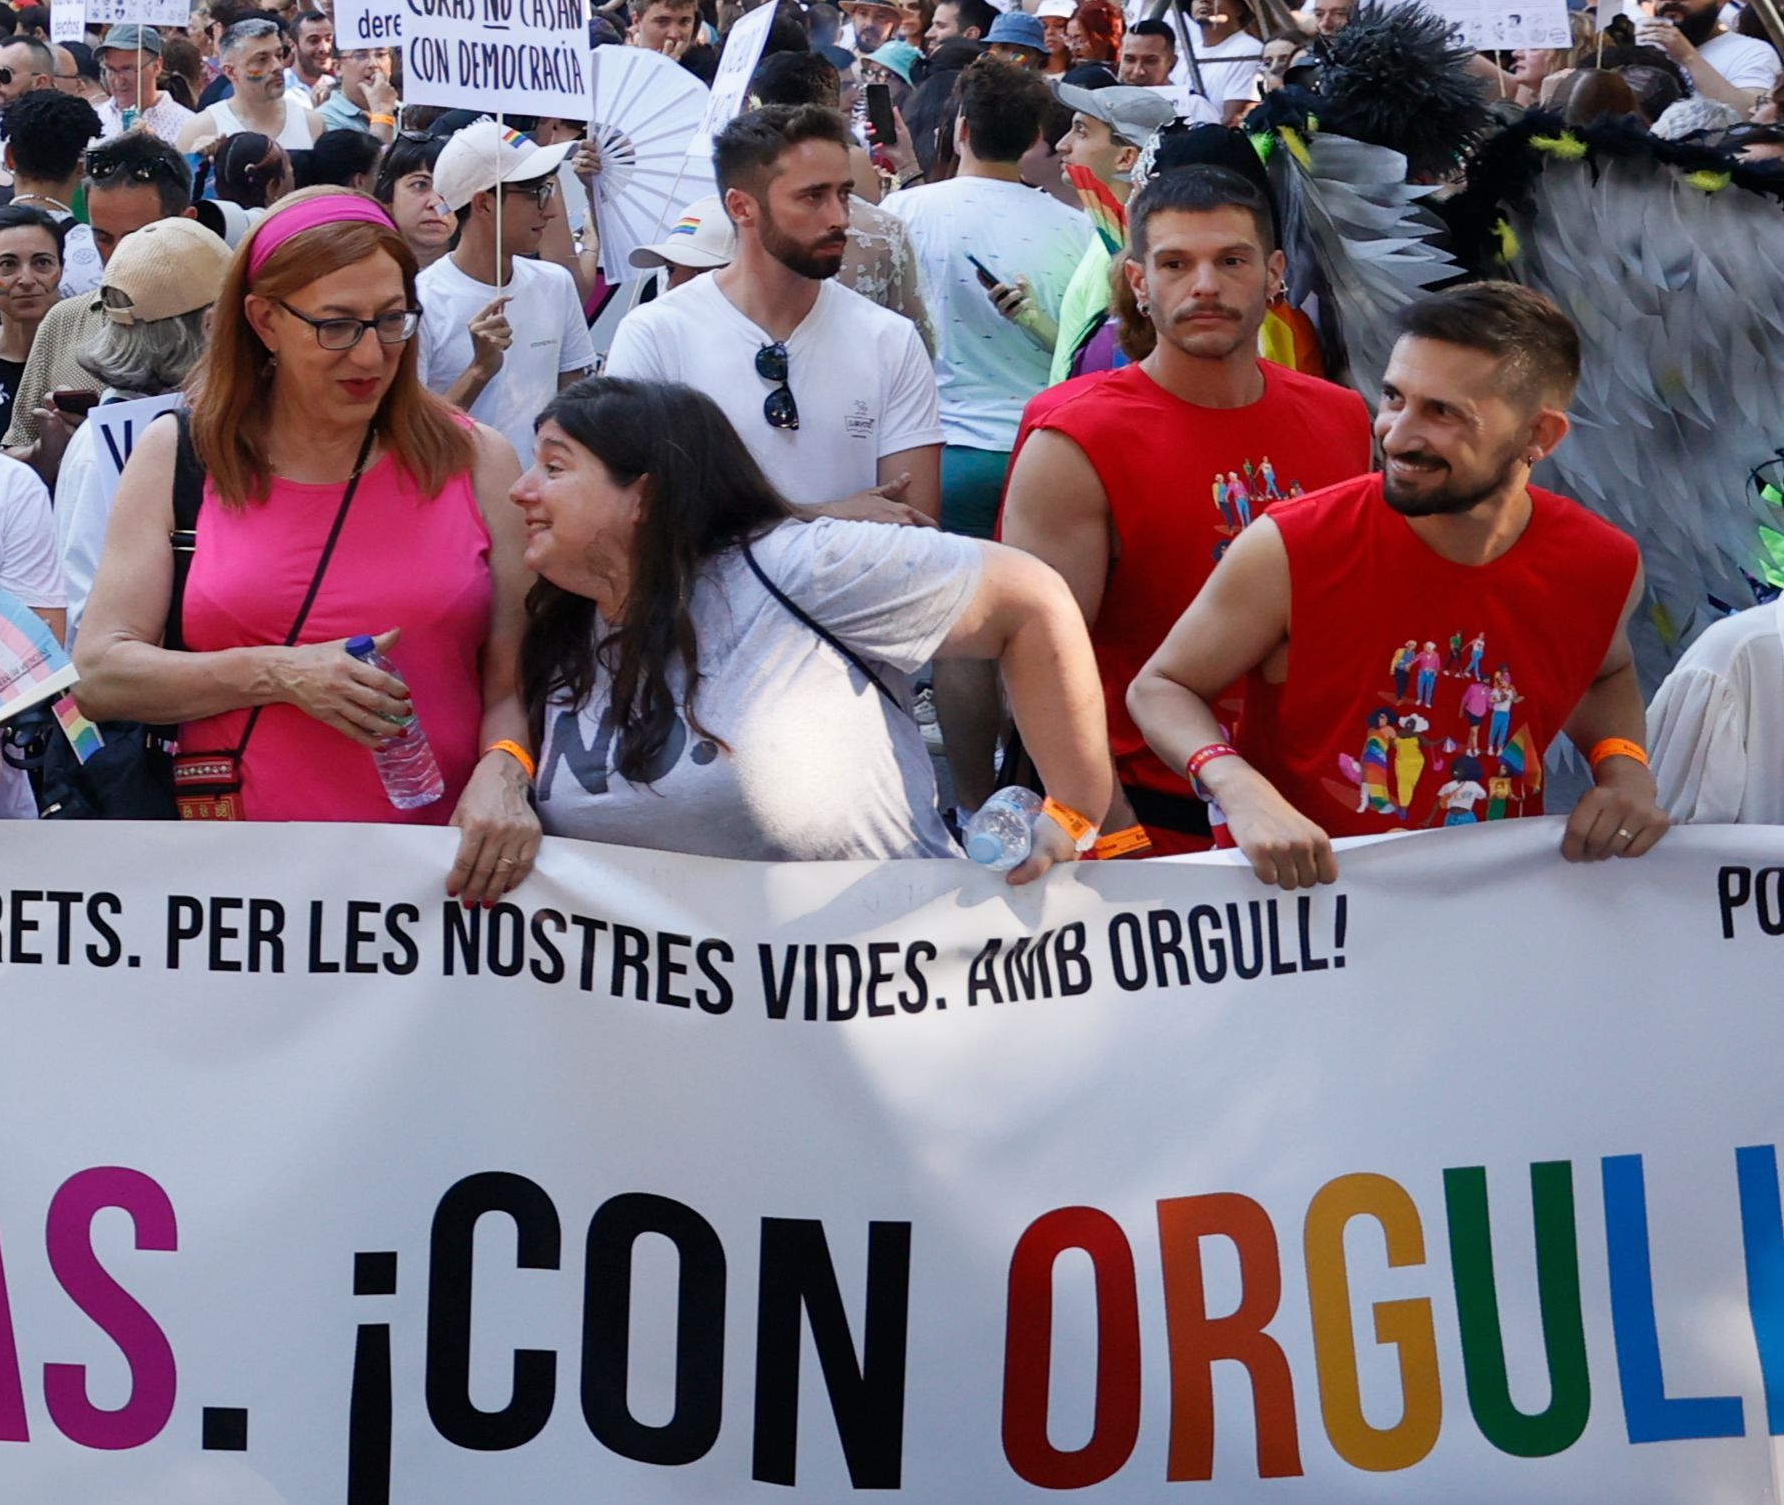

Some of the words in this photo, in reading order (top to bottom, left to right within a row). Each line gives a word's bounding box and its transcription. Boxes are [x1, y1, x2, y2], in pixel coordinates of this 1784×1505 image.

[358, 8, 402, 40] dere
[410, 36, 451, 84] CON
[167, 896, 285, 974] PER
[309, 901, 420, 976] LES
[443, 902, 734, 1015] NOSTRES
[758, 941, 946, 1022] VIDES.
[969, 922, 1092, 1006] AMB
[1109, 895, 1347, 992] ORGULL!
[348, 1171, 912, 1505] ¡CON
